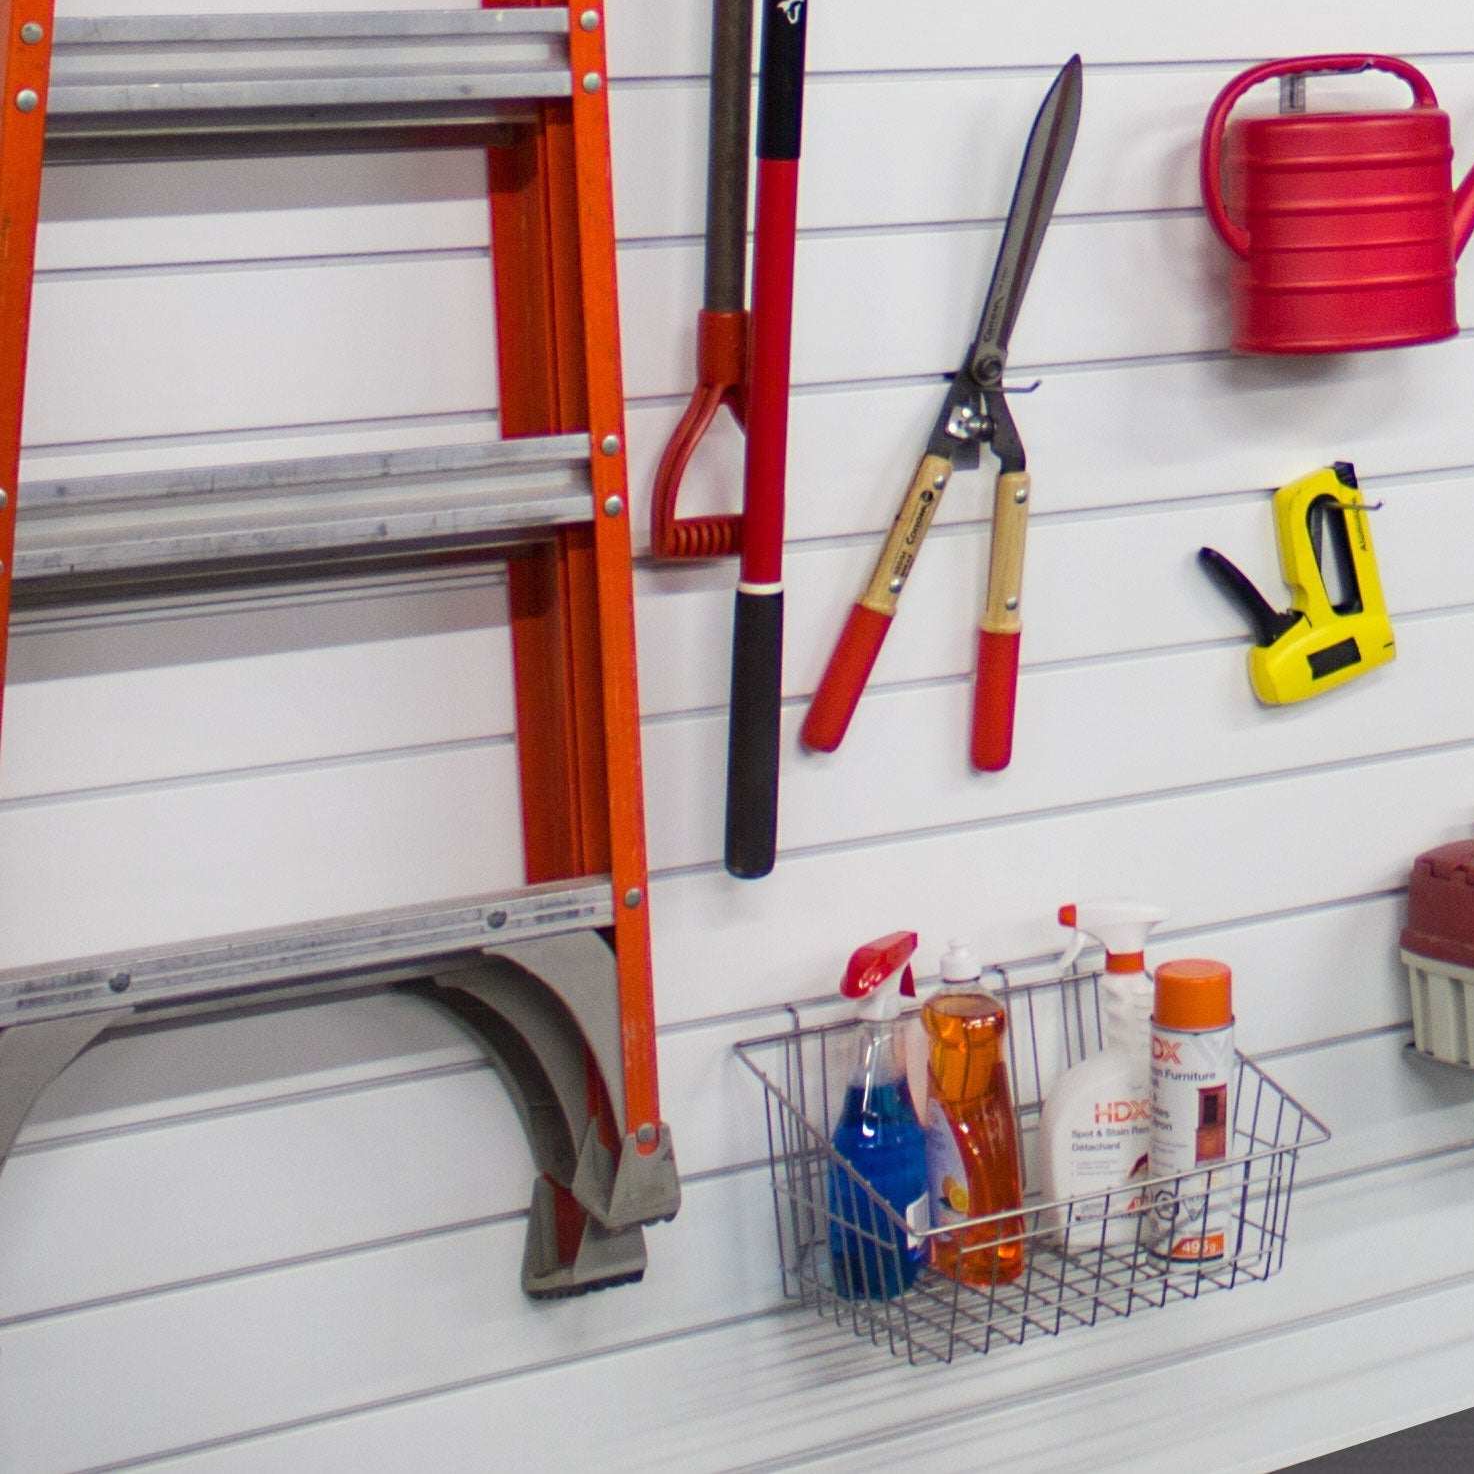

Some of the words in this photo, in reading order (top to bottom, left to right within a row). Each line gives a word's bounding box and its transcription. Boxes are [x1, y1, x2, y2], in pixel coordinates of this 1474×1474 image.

[1151, 1034, 1182, 1065] DX
[1164, 1069, 1216, 1082] Furniture
[1094, 1099, 1150, 1124] HDX
[1071, 1128, 1094, 1141] Spot
[1105, 1125, 1130, 1138] Stain
